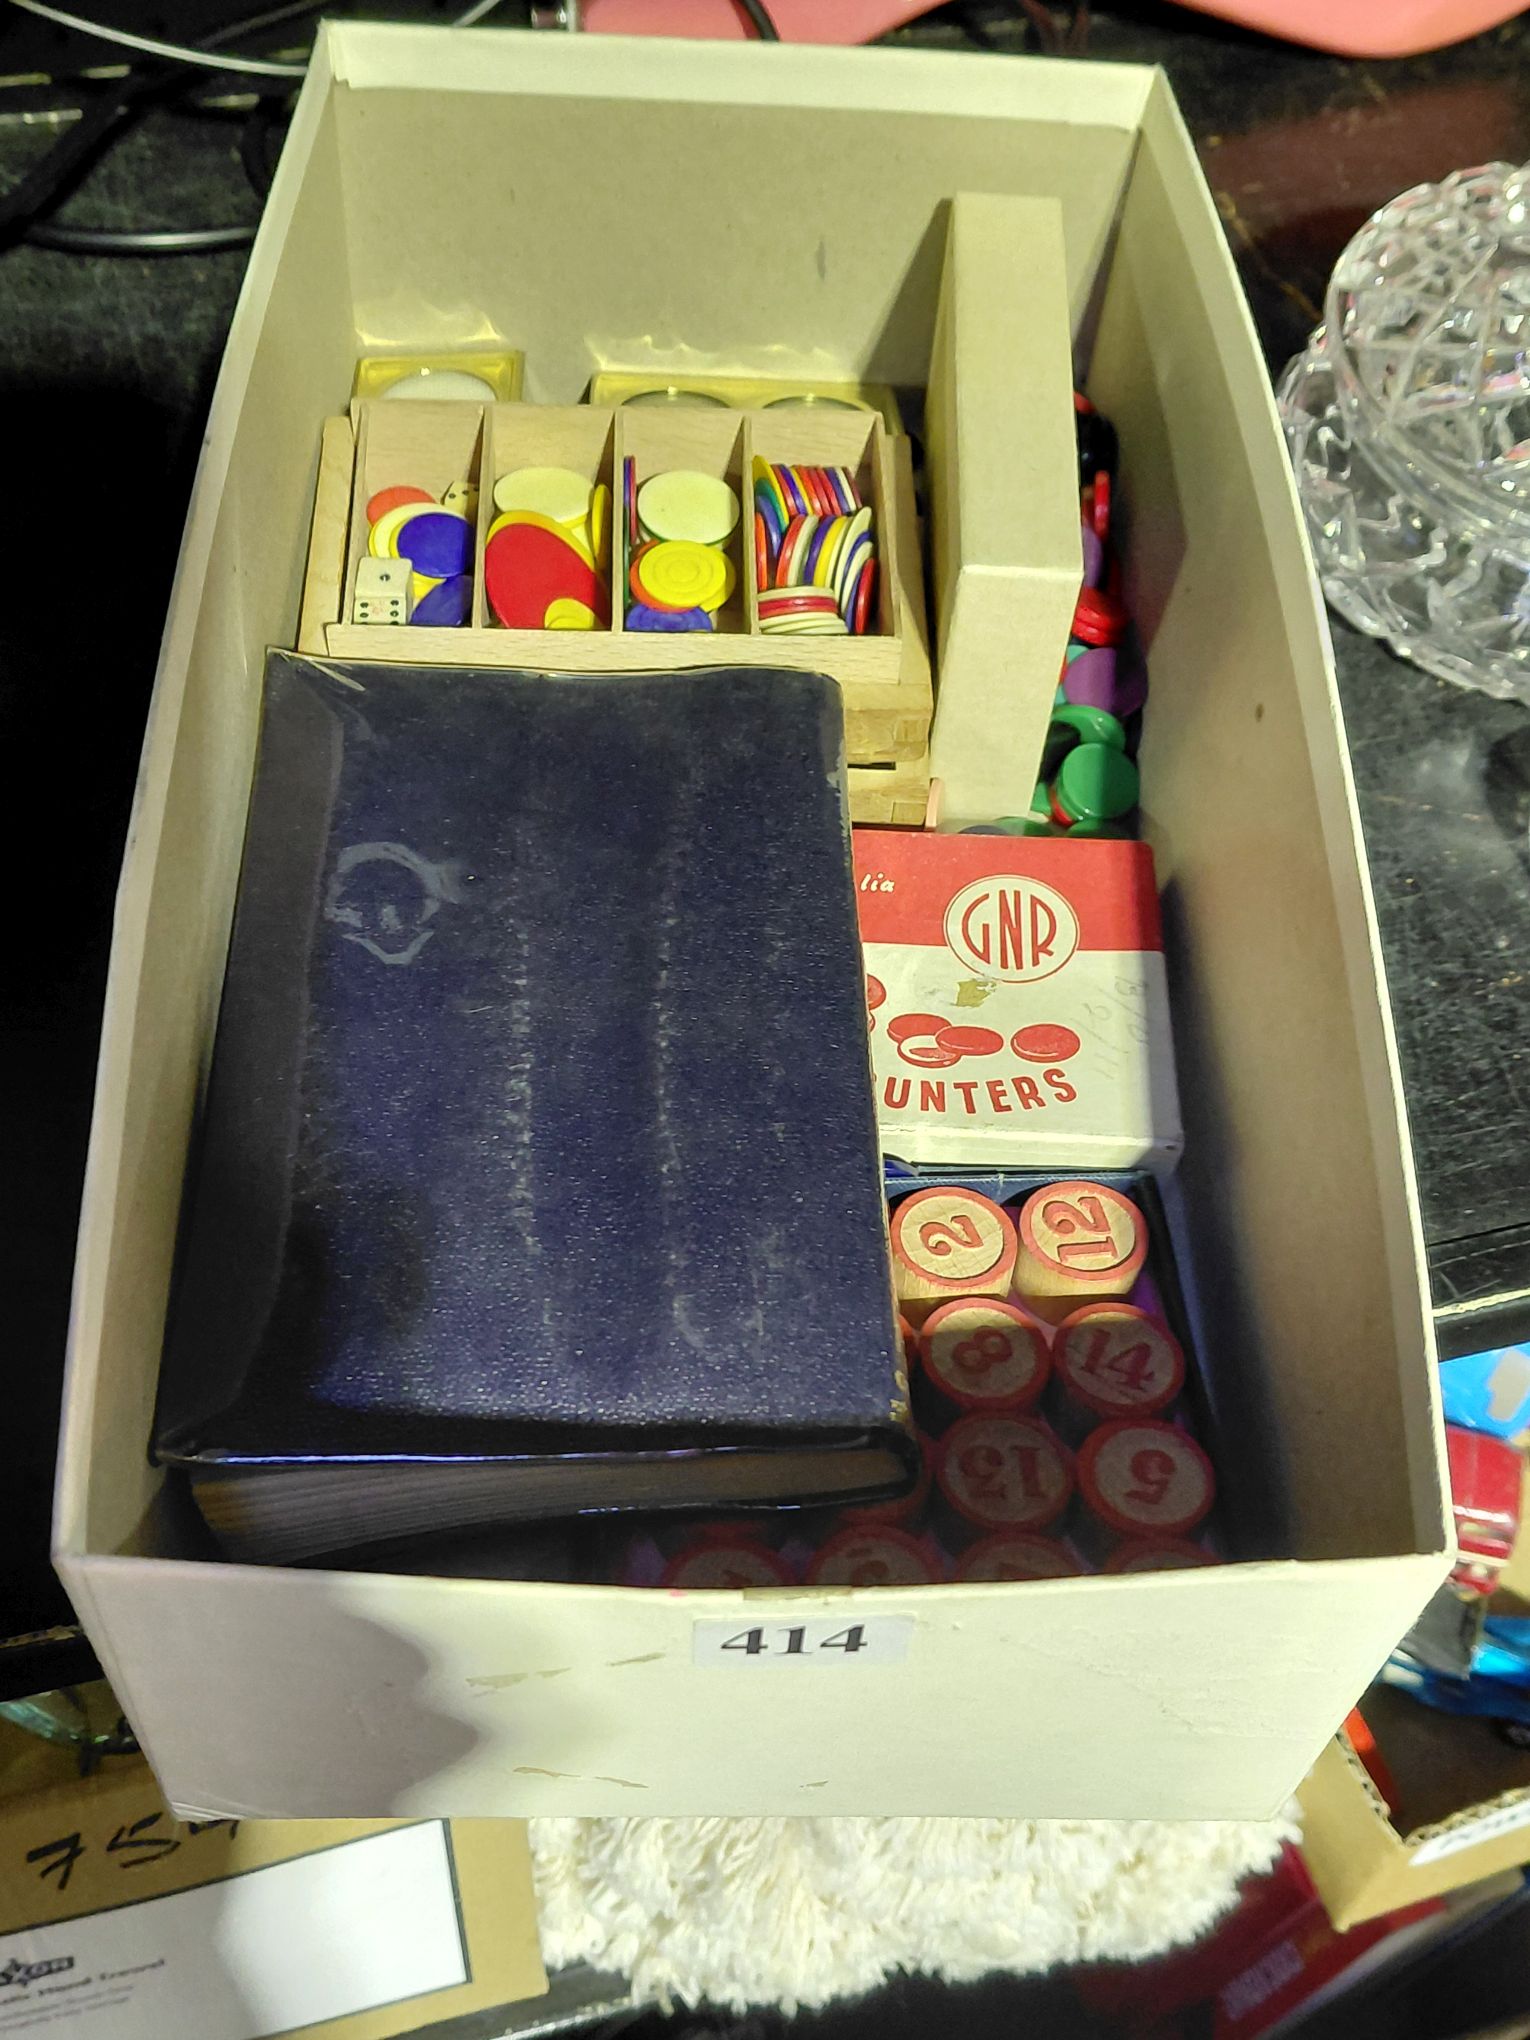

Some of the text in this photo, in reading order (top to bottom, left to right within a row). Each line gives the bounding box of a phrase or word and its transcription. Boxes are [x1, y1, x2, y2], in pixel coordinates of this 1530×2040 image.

[961, 889, 1057, 970] GNR
[874, 1068, 1078, 1114] UNTERS
[918, 1213, 984, 1258] 2
[1041, 1195, 1119, 1264] 12
[950, 1325, 1013, 1375] 8
[1078, 1328, 1156, 1391] 14
[957, 1445, 1048, 1501] 13
[1123, 1448, 1177, 1504] 5
[719, 1623, 869, 1656] 414
